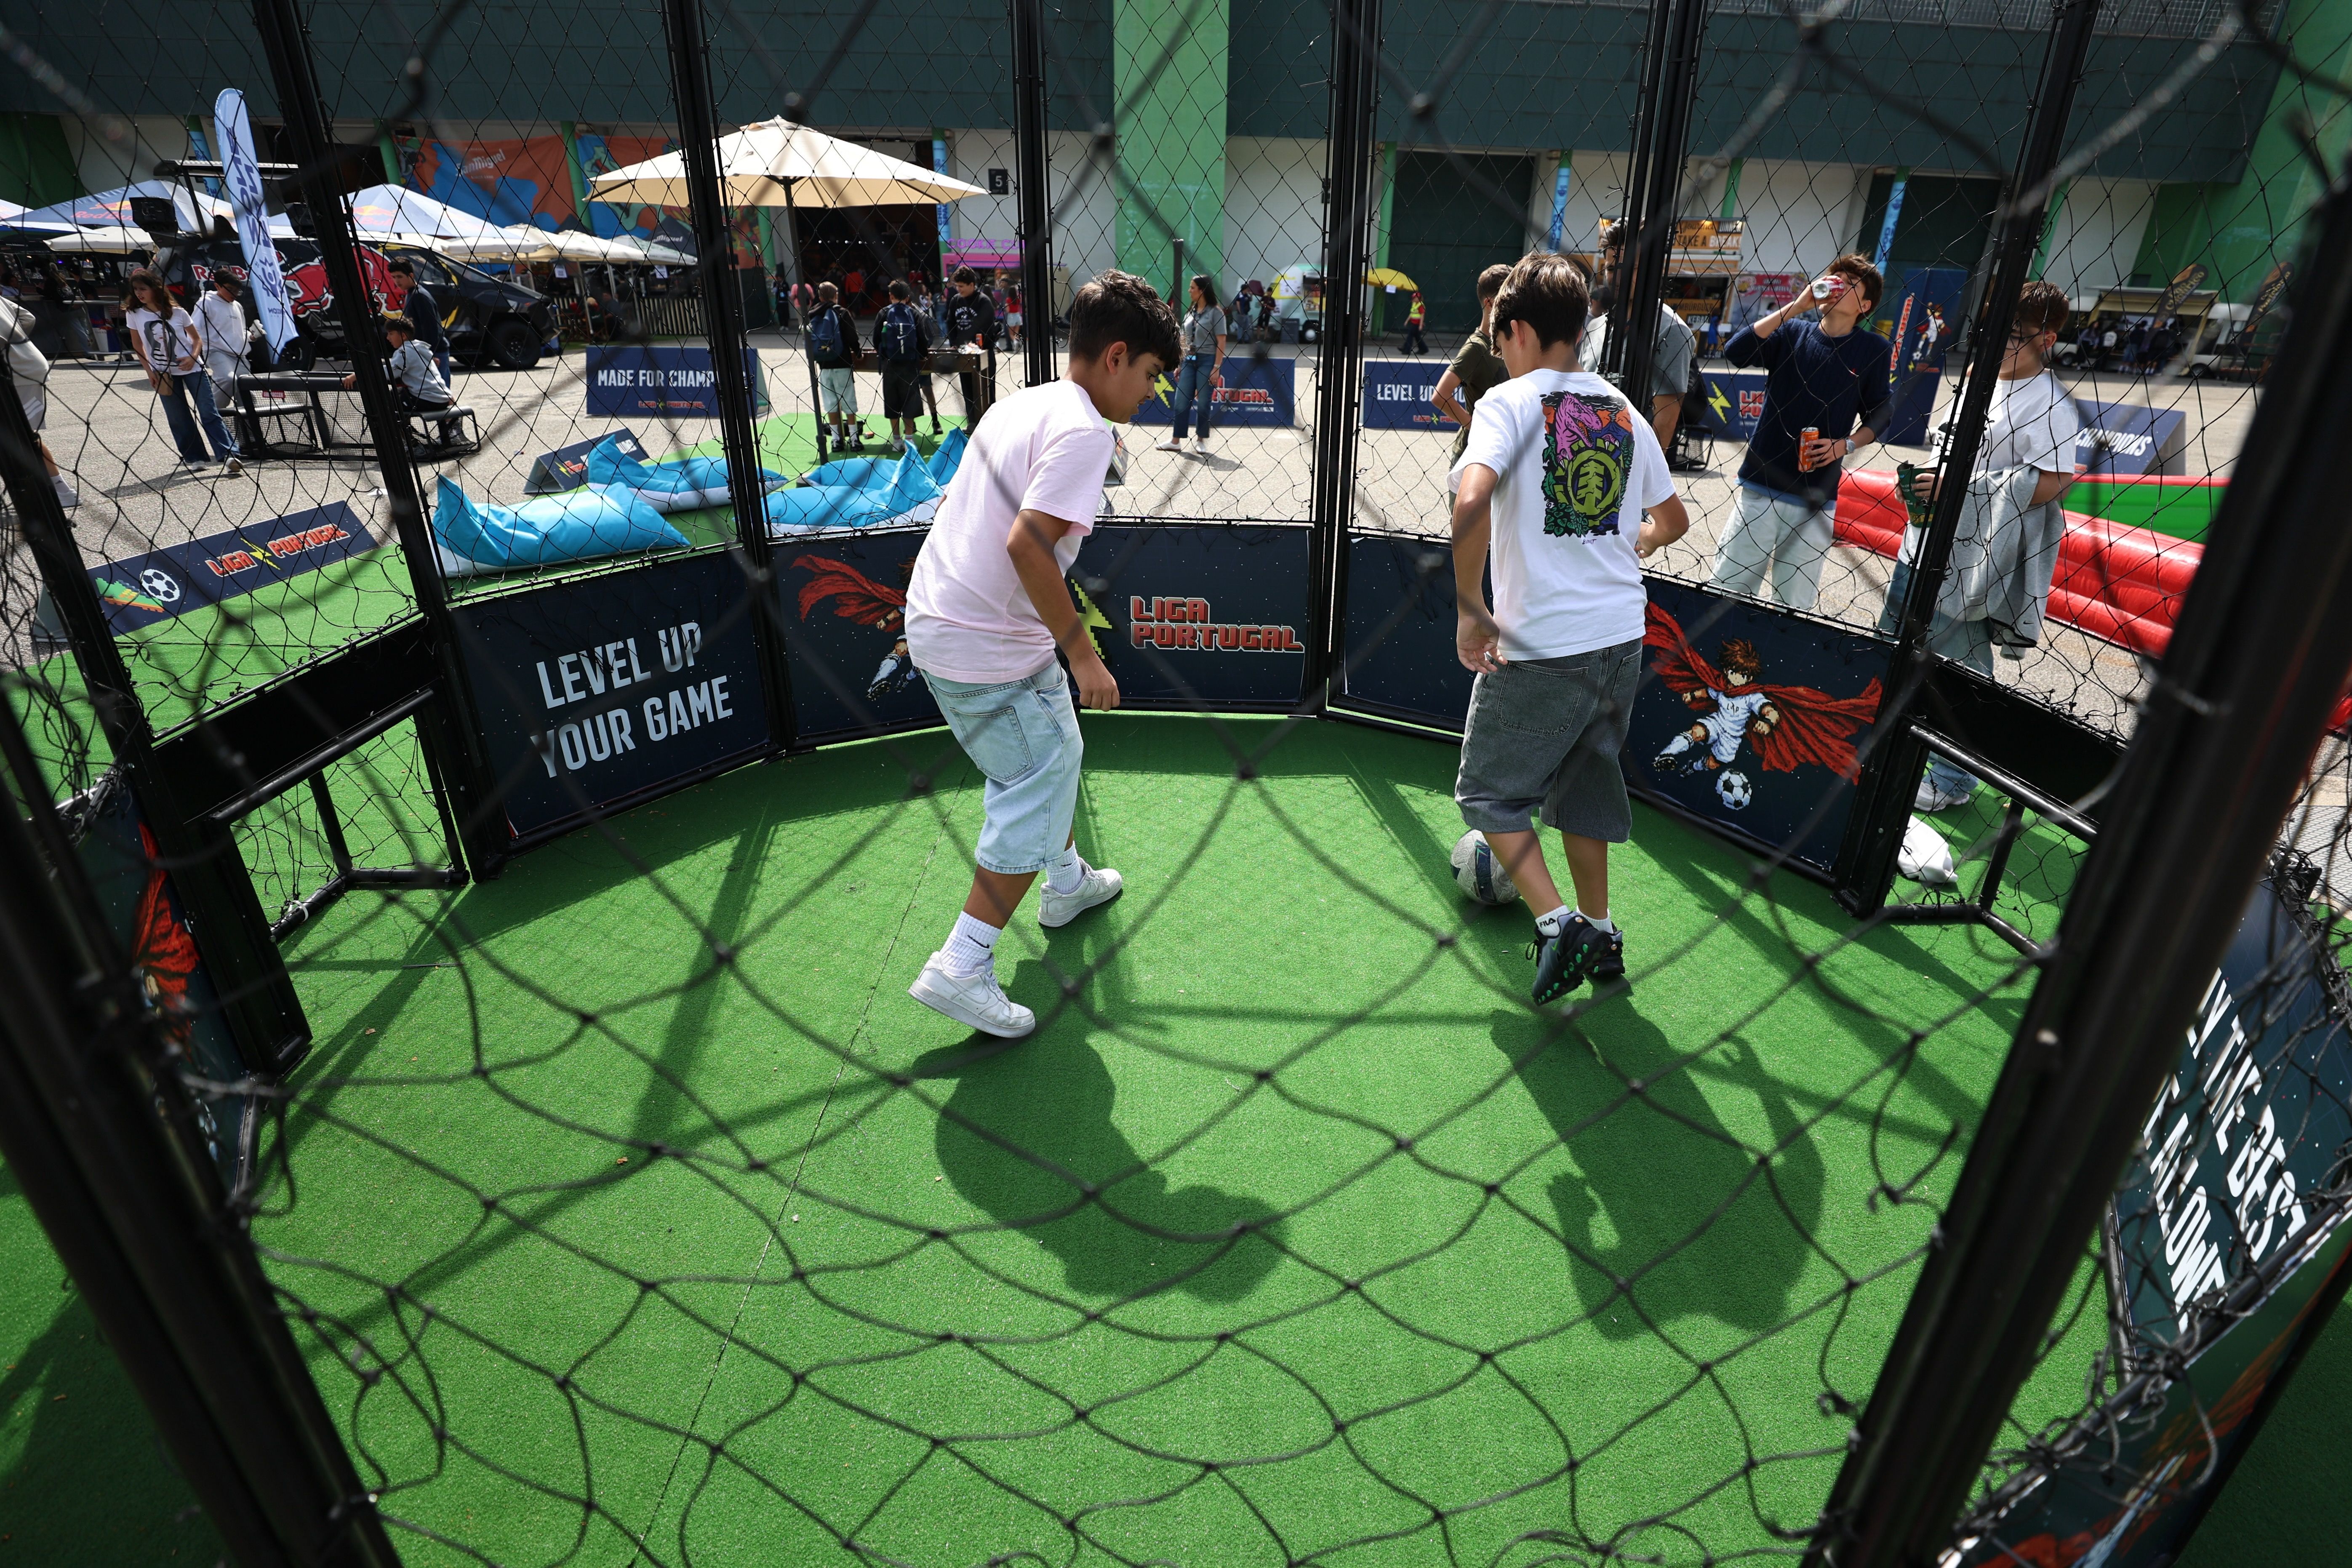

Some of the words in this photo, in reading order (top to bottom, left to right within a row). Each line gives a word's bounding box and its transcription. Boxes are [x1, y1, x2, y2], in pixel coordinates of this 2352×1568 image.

[995, 175, 1003, 187] 5
[947, 238, 997, 249] COOKIE
[1678, 235, 1699, 246] TAKE
[1701, 235, 1707, 246] A
[597, 369, 635, 387] MADE
[639, 370, 665, 387] FOR
[669, 369, 715, 388] CHAMP
[1376, 384, 1416, 401] LEVEL
[1211, 387, 1274, 404] TUGAL
[1739, 390, 1765, 405] LIG
[2075, 427, 2152, 456] CHAMPIONS
[205, 550, 258, 577] LIGA
[267, 523, 351, 558] PORTUGAL
[1130, 596, 1210, 624] LIGA
[1130, 623, 1306, 653] PORTUGAL
[536, 637, 652, 709] LEVEL
[658, 621, 702, 673] UP
[531, 709, 636, 778] YOUR
[643, 675, 733, 741] GAME
[1539, 917, 1556, 928] FILA
[2203, 1014, 2262, 1155] THE
[2227, 1104, 2307, 1262] BEST
[2150, 1112, 2227, 1334] ALLOWE
